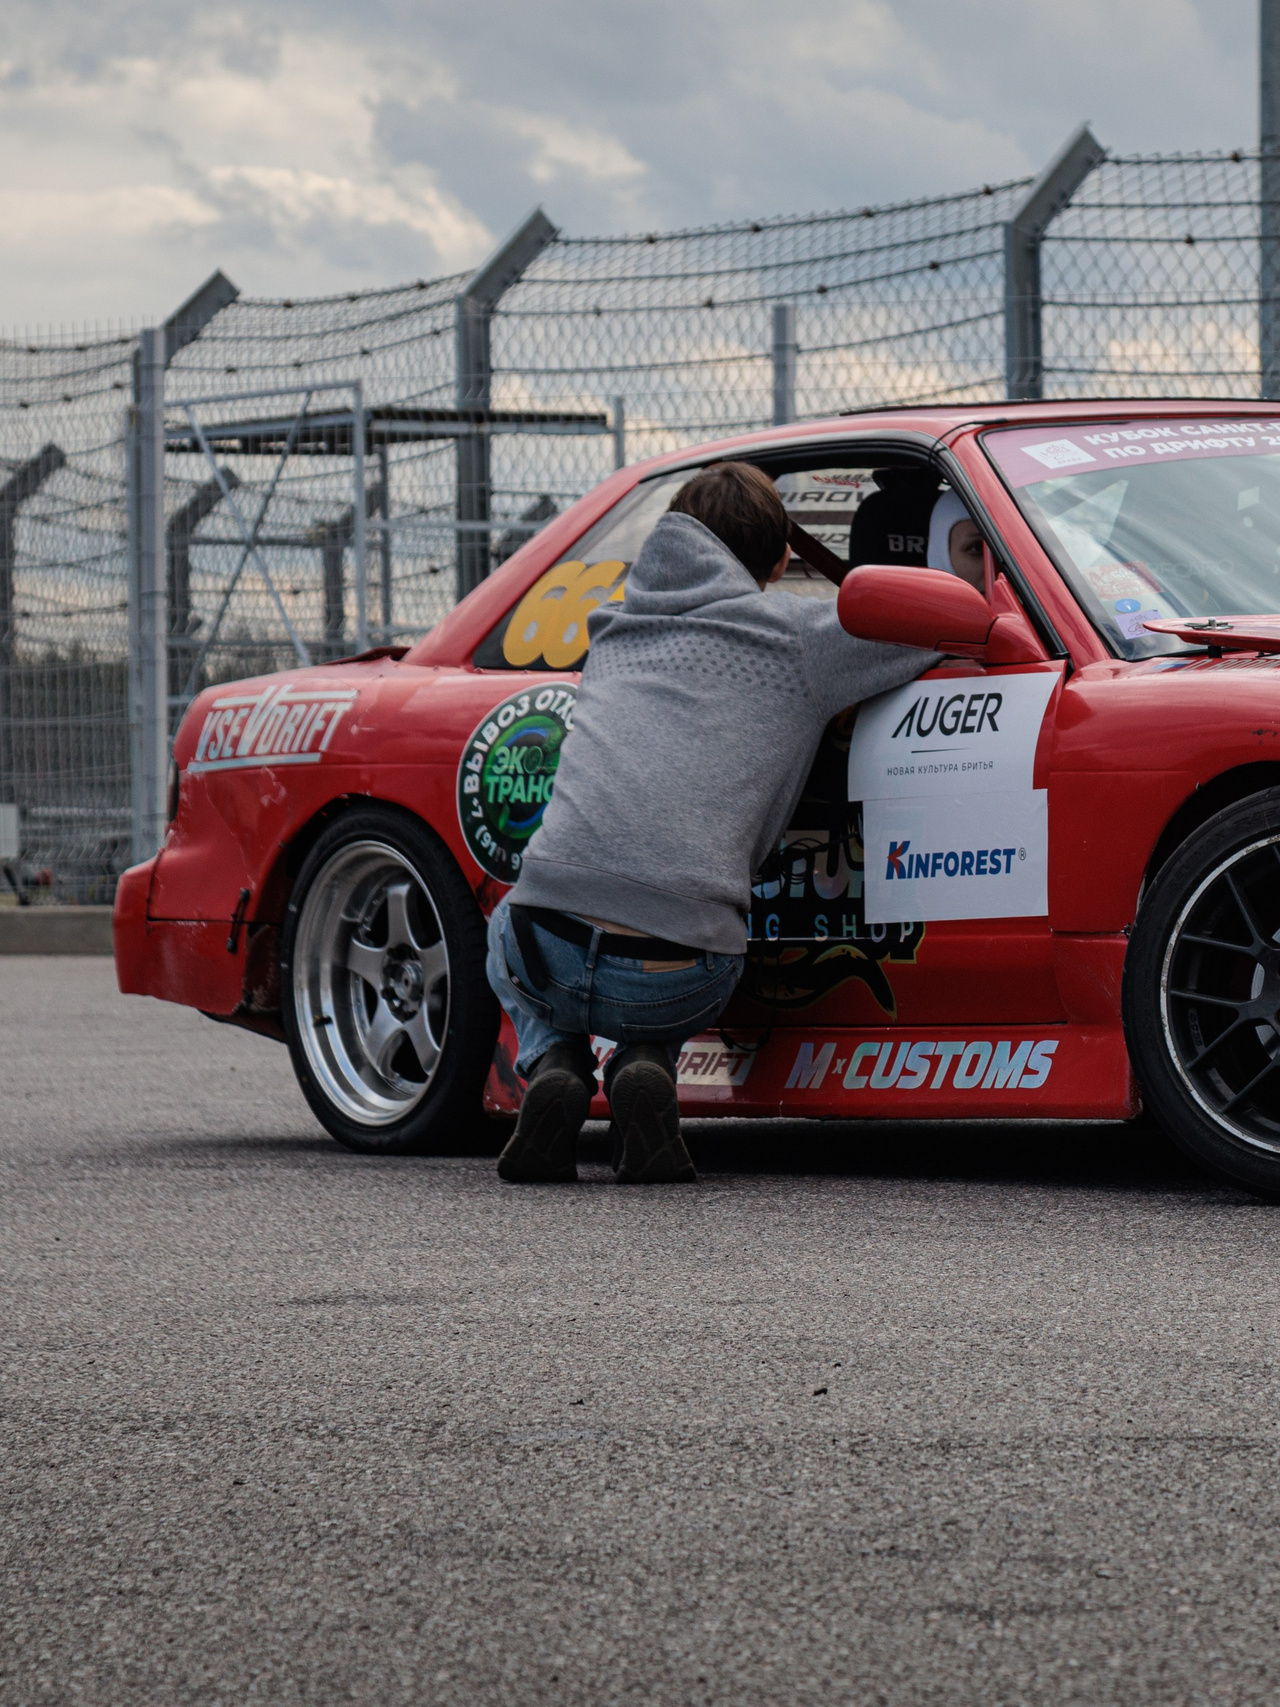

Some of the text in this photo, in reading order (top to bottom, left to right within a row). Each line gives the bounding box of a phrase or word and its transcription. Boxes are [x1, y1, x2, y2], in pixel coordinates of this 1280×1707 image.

[1083, 425, 1179, 445] КУБОК
[1101, 445, 1146, 459] ПО
[1150, 436, 1256, 455] ДРИФТУ
[886, 534, 929, 553] BR
[503, 561, 625, 669] 66
[193, 684, 355, 762] VSEVDRIFT
[890, 692, 1003, 739] AUGER
[463, 694, 531, 794] ВЫВОЗ
[886, 760, 994, 776] НОВАЯ КУЛЬТУРА БРИТЬЯ
